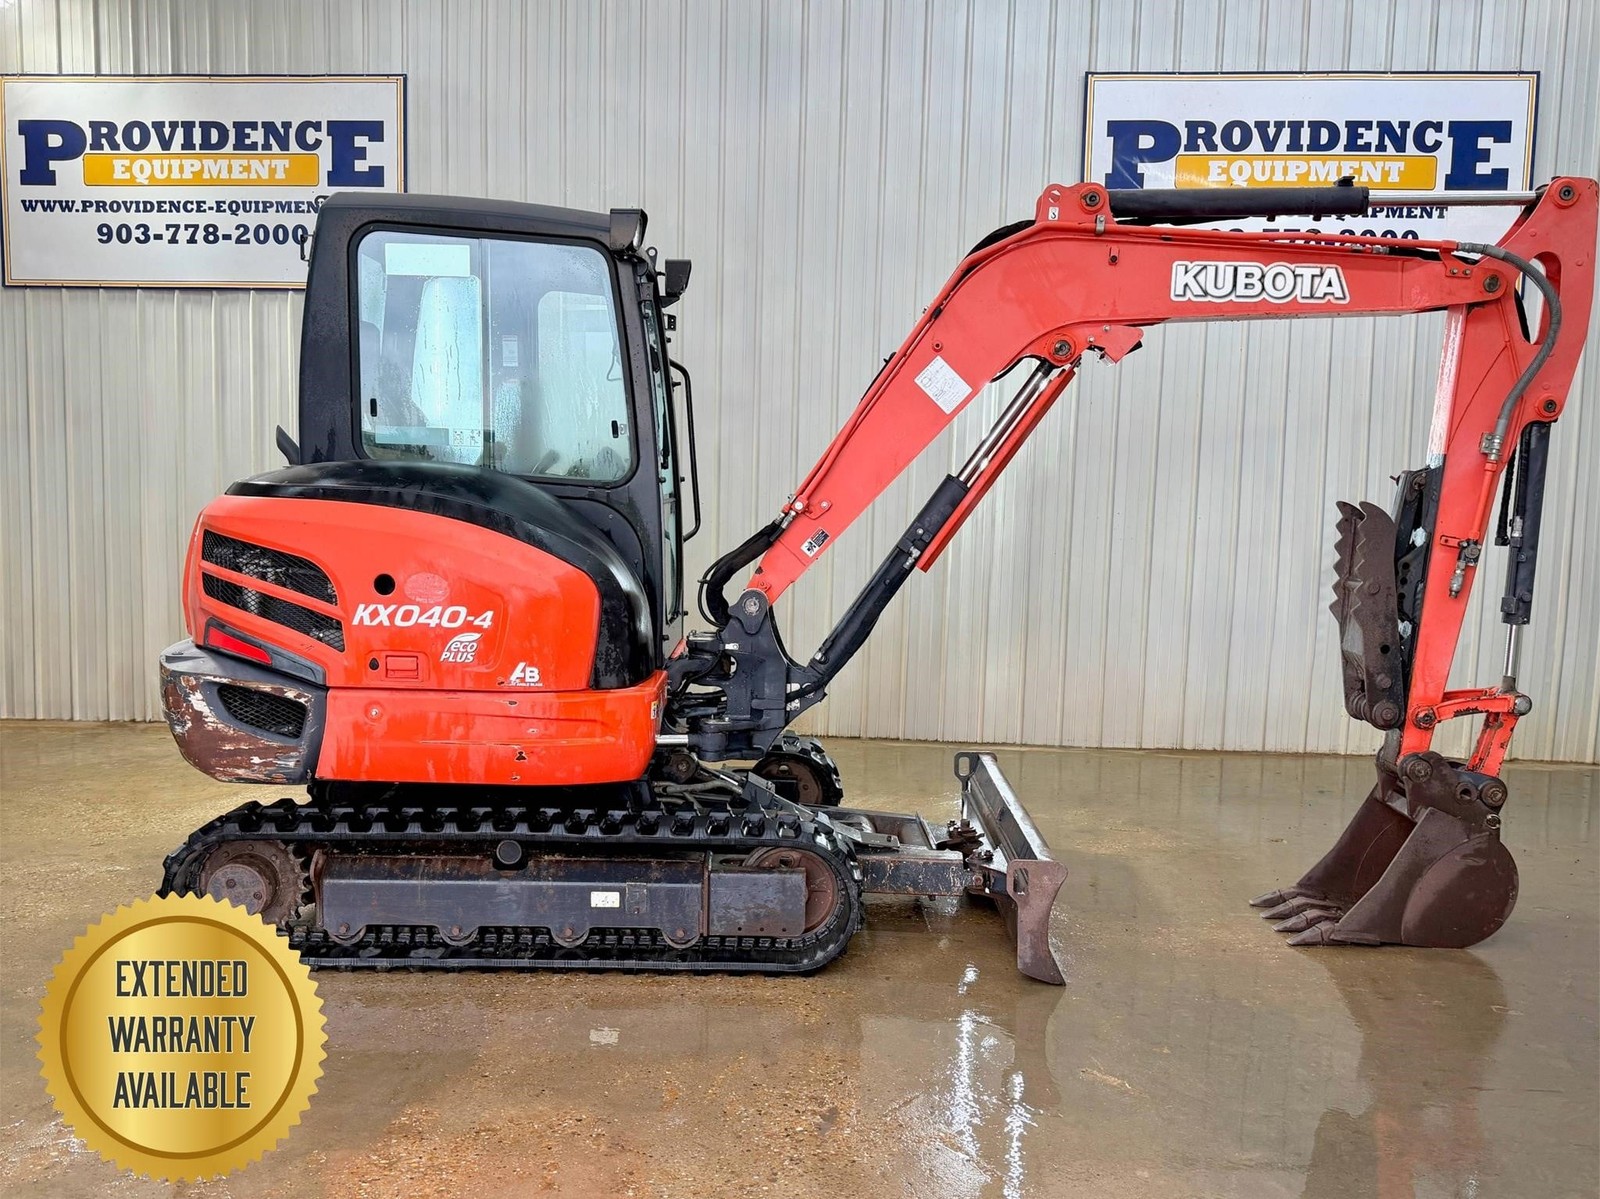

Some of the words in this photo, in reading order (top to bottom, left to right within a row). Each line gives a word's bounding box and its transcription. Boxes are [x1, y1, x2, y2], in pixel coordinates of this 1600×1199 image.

[18, 119, 385, 187] PROVIDENCE
[1104, 119, 1512, 190] PROVIDENCE
[112, 158, 290, 185] EQUIPMENT
[1207, 160, 1405, 187] EQUIPMENT
[20, 199, 320, 217] WWW.PROVIDENCE-EQUIPMEN
[97, 223, 309, 245] 903-778-2000
[1173, 263, 1348, 301] KUBOTA
[352, 603, 494, 629] KX040-4
[440, 652, 475, 663] PLUS
[450, 641, 477, 652] eco
